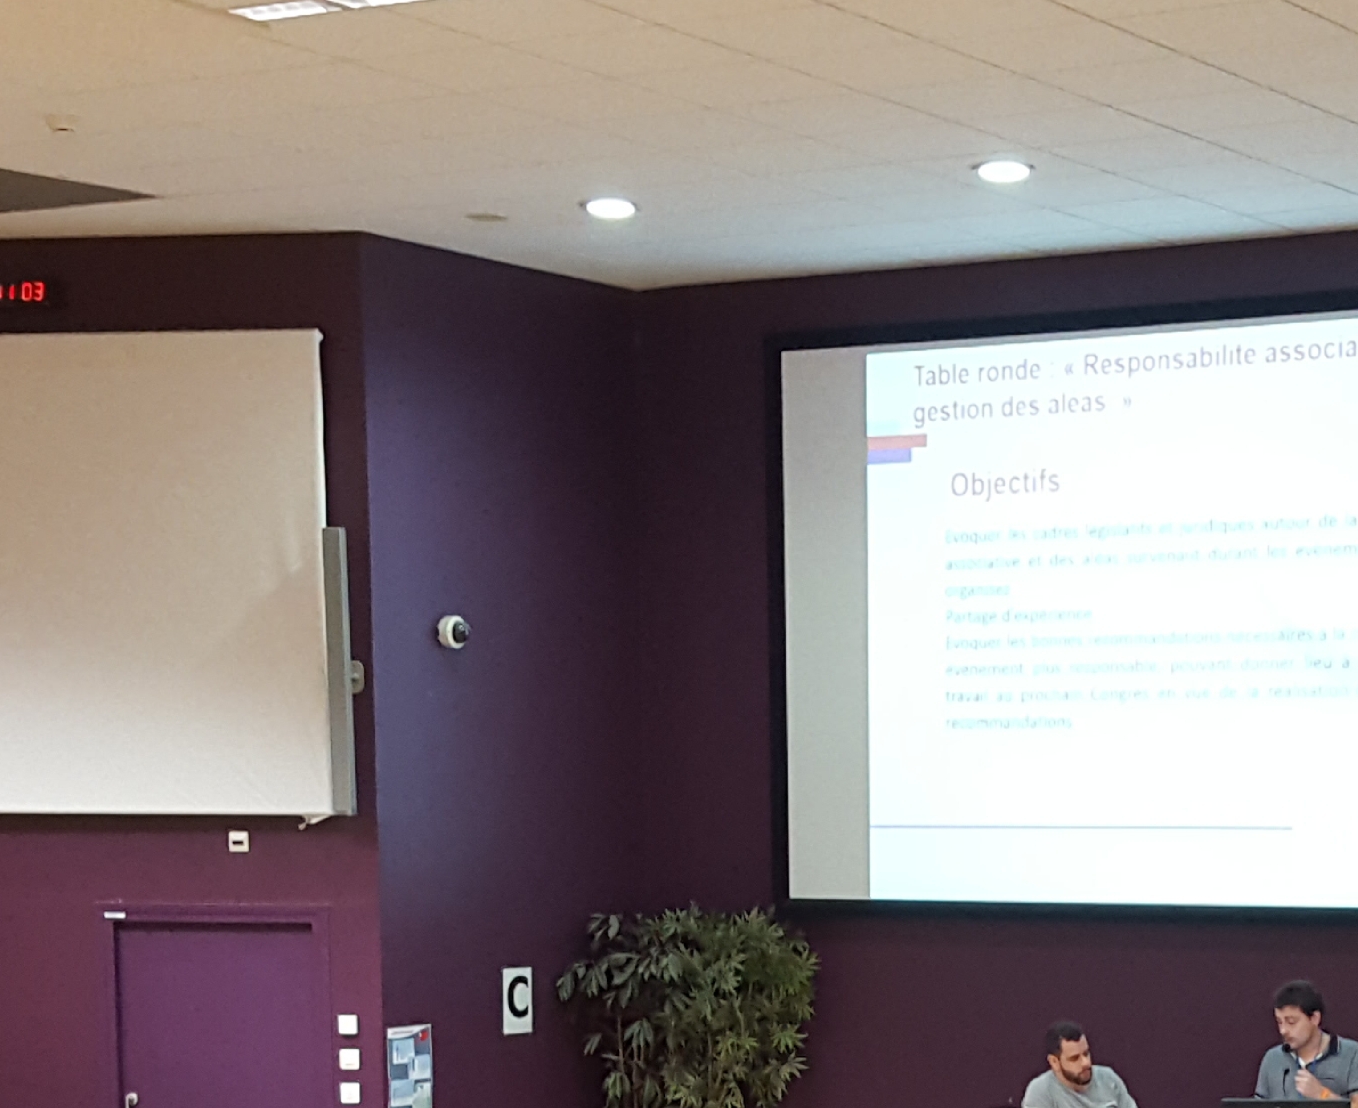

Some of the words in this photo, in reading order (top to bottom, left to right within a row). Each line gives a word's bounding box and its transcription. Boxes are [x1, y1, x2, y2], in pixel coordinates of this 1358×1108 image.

[914, 362, 970, 387] Table
[977, 358, 1041, 382] ronde
[913, 396, 993, 430] gestion
[1001, 393, 1040, 419] des
[950, 469, 1061, 502] Objectifs
[507, 975, 529, 1018] C
